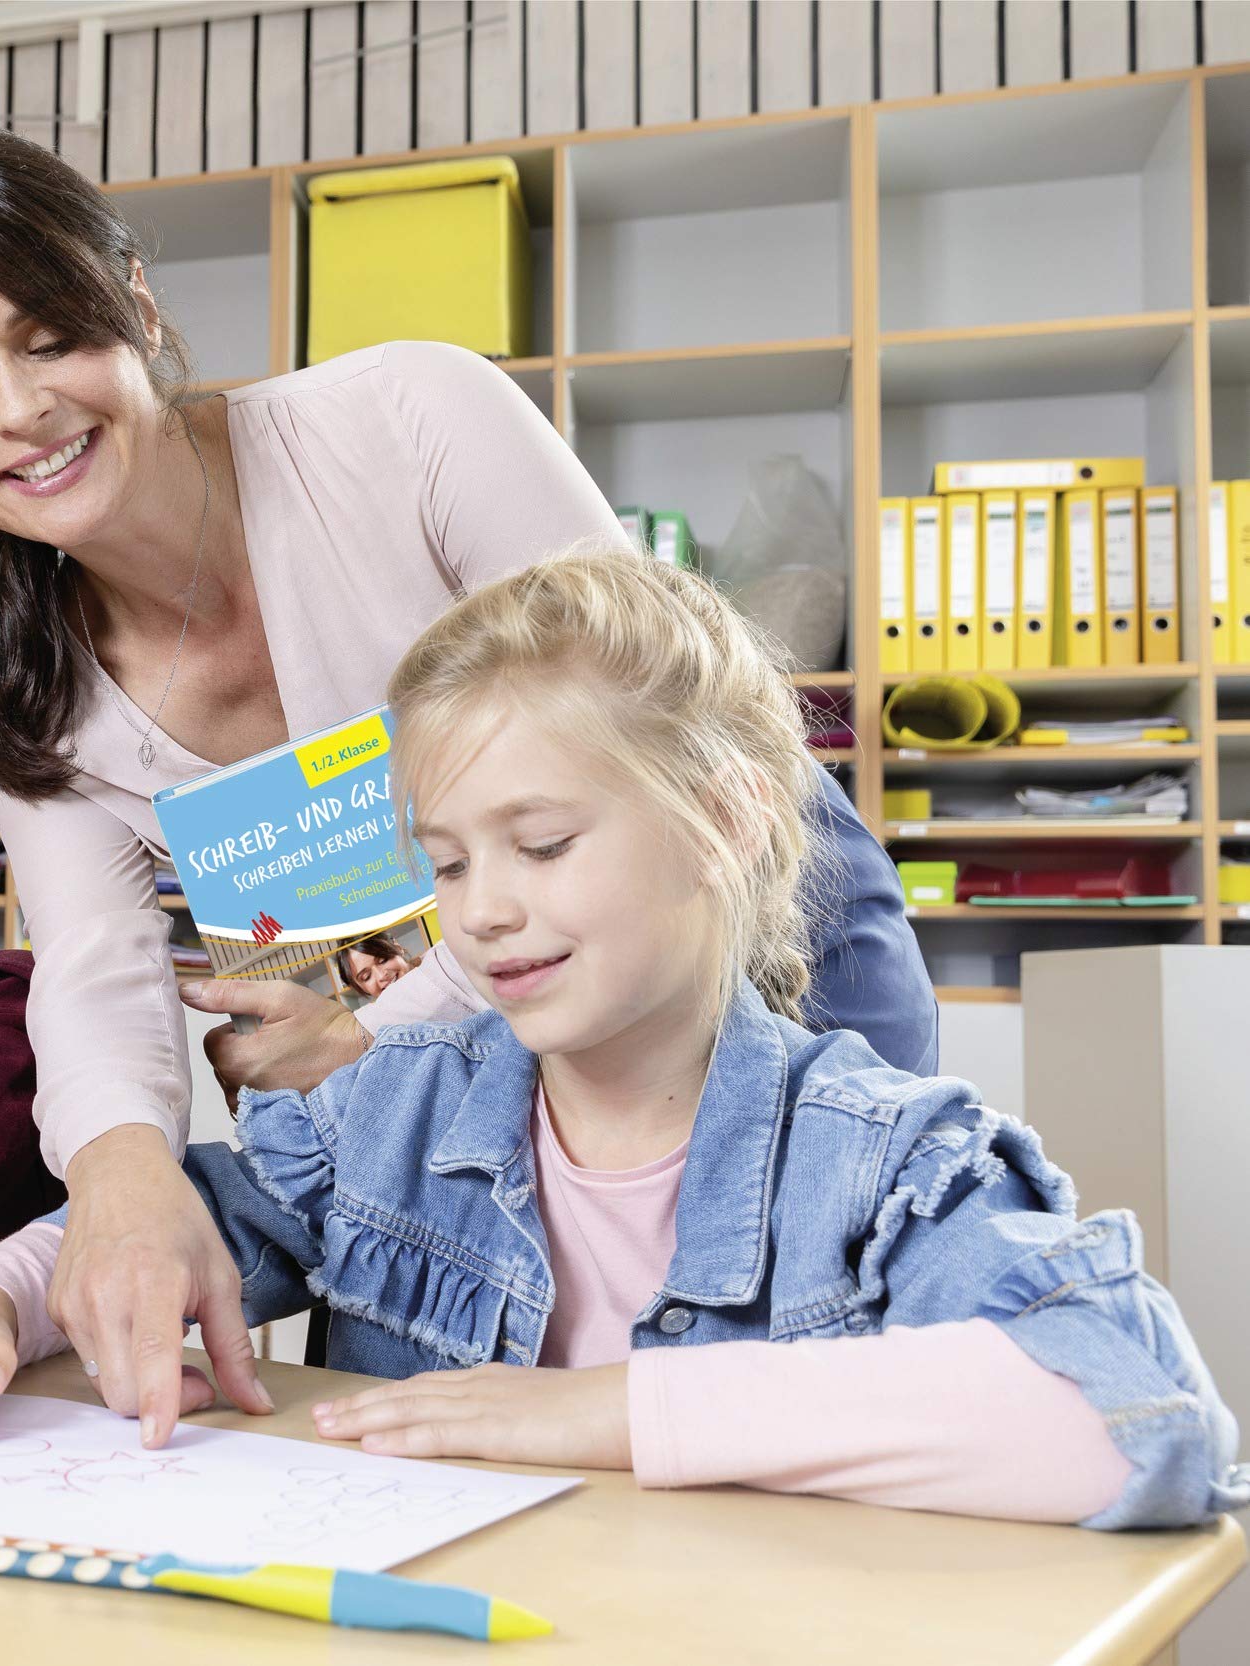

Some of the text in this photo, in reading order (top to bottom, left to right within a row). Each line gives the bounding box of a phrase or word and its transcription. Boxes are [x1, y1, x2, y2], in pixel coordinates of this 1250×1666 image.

[338, 738, 380, 761] Klasse
[188, 822, 288, 878] SCHREIB-
[296, 797, 343, 833] UND
[233, 846, 314, 894] SCHREIBEN
[317, 817, 379, 858] LERNEN
[296, 858, 383, 901] Praxisbuch zur
